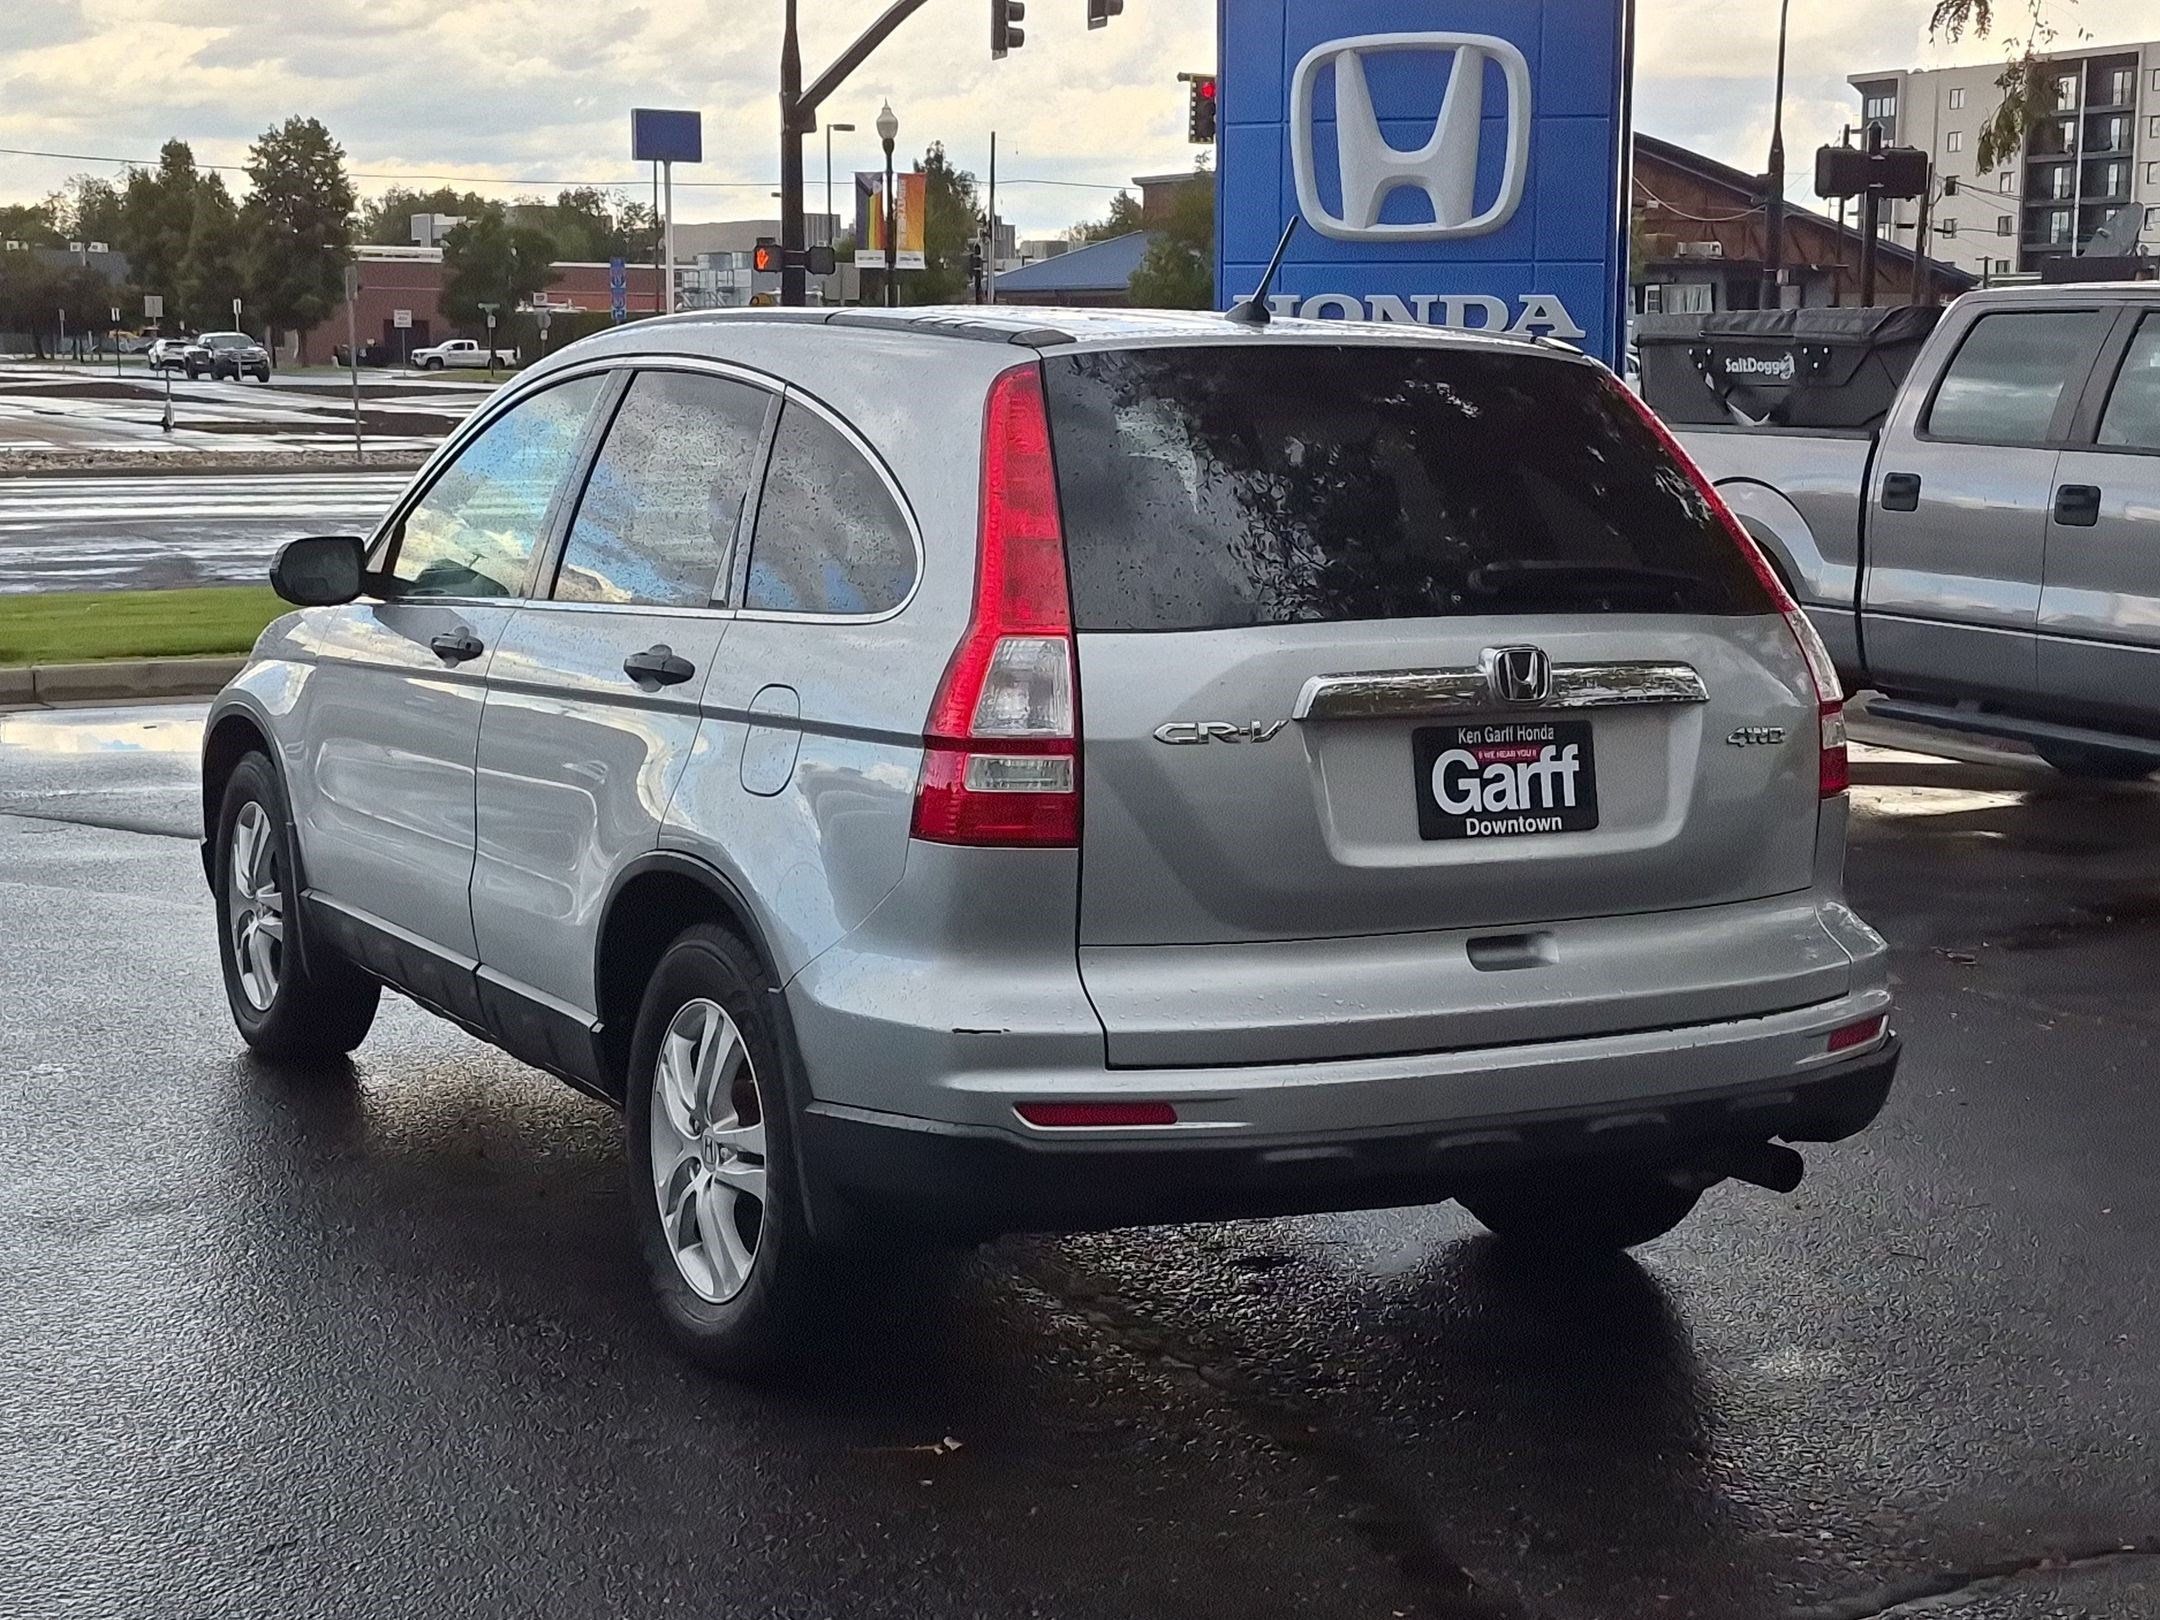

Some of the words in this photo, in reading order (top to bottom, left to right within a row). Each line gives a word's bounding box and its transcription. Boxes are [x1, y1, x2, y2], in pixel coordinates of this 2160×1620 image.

[1153, 720, 1290, 744] CR-V
[1458, 727, 1482, 744] Ken
[1484, 725, 1514, 743] Garff
[1516, 724, 1555, 741] Honda
[1727, 726, 1785, 747] 4WD
[1431, 743, 1580, 815] Garff
[1465, 815, 1563, 837] Downtown
